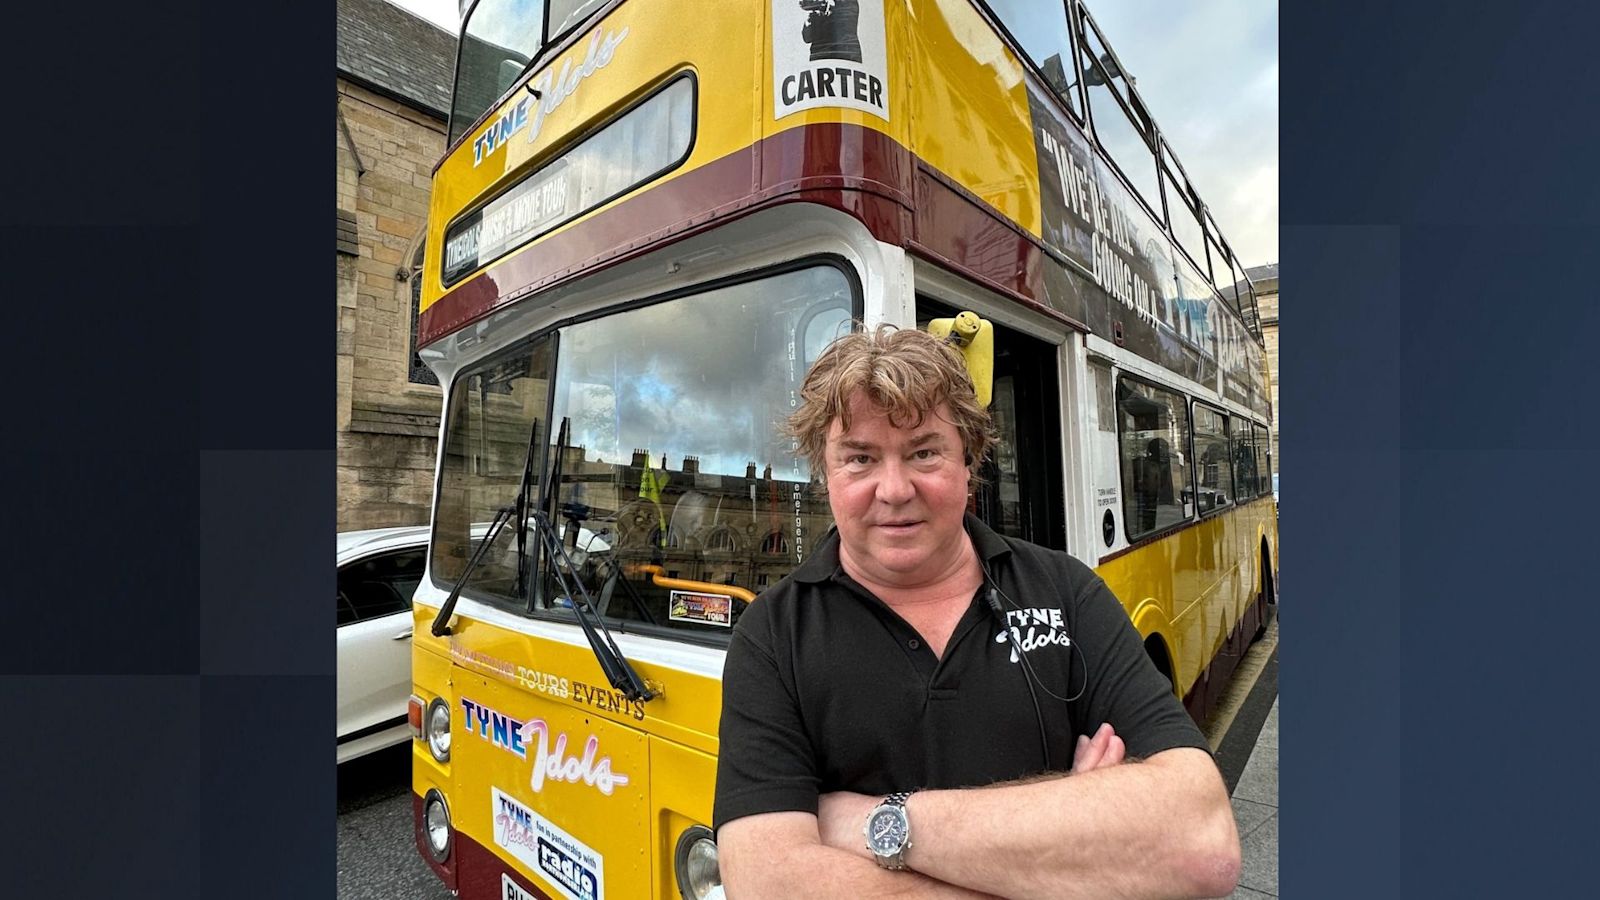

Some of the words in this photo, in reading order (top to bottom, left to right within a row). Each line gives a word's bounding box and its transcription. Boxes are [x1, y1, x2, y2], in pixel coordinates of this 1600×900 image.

[782, 67, 883, 109] CARTER
[473, 95, 529, 168] TYNE
[1110, 200, 1134, 256] ALL
[1091, 231, 1134, 311] GOING
[1133, 271, 1150, 325] ON
[1151, 289, 1159, 332] A
[793, 483, 803, 563] emergency
[1006, 607, 1065, 627] TYNE
[995, 626, 1071, 664] Idols
[517, 666, 569, 699] TOURS
[572, 681, 646, 721] EVENTS
[461, 697, 526, 761] TYNE
[519, 719, 630, 796] Idols
[499, 795, 533, 832] TYNE
[541, 843, 594, 893] radio
[551, 833, 582, 860] partnership
[583, 854, 597, 870] with
